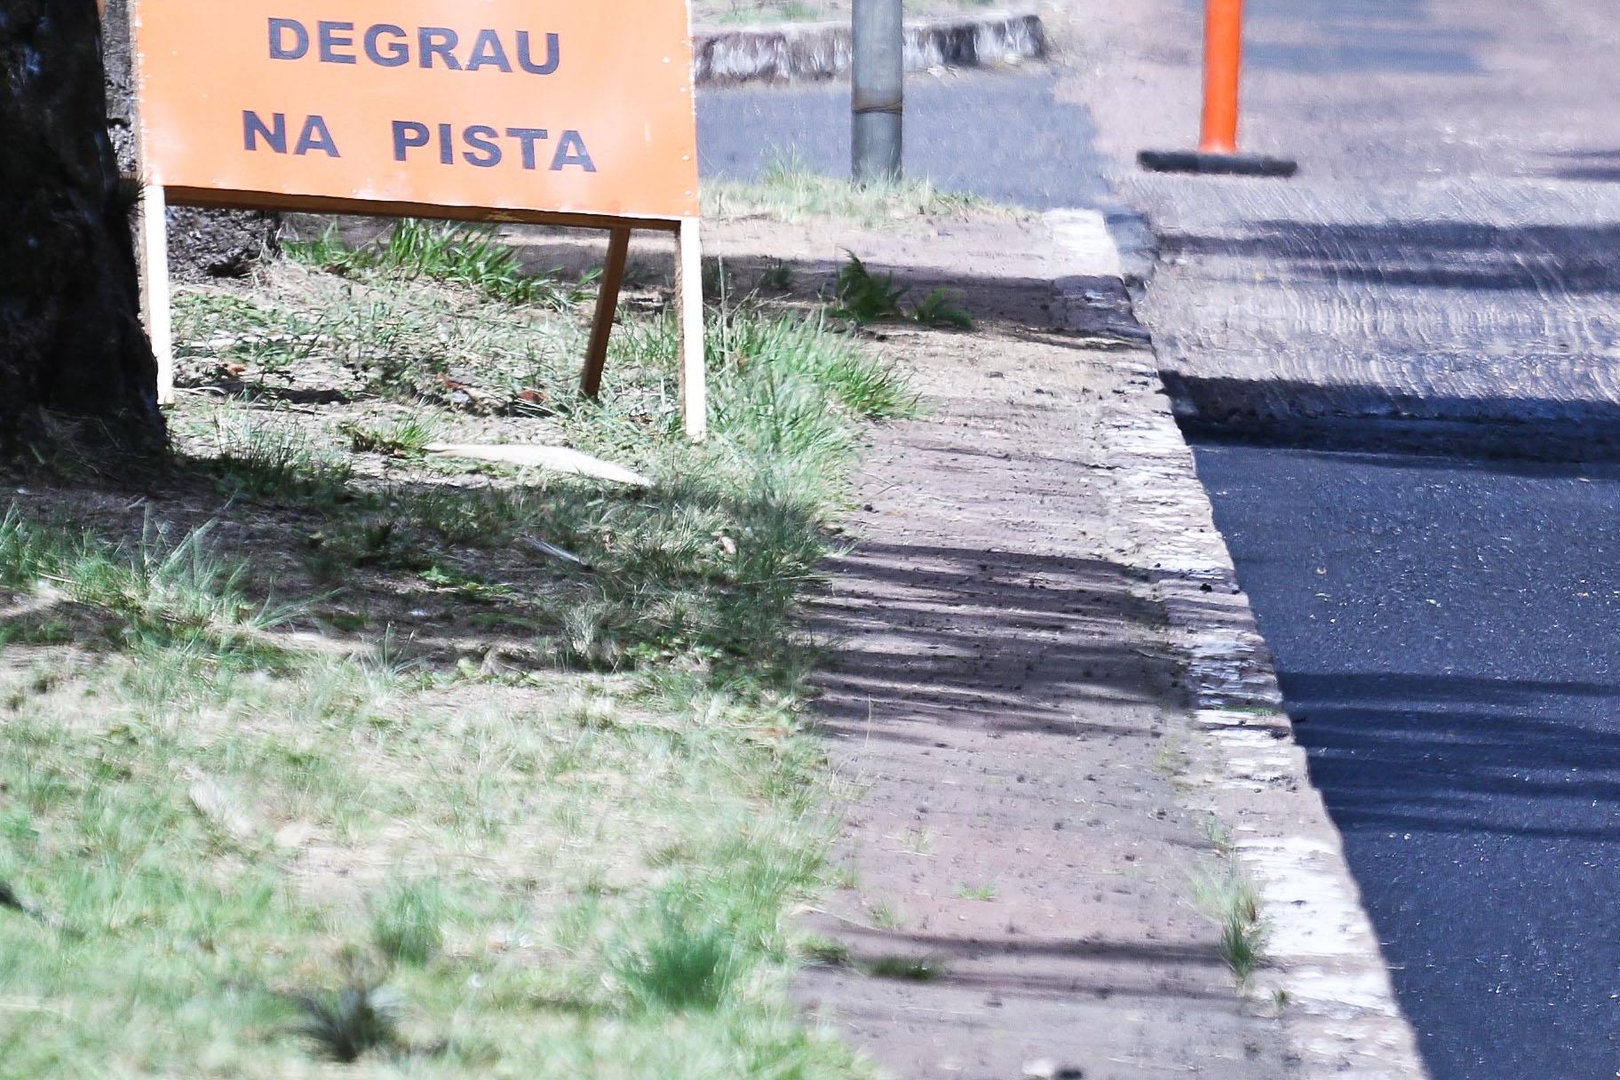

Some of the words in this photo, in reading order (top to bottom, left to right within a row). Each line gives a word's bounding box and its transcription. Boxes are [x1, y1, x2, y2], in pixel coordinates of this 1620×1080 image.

[267, 17, 560, 75] DEGRAU
[242, 110, 341, 158] NA
[391, 120, 597, 173] PISTA
